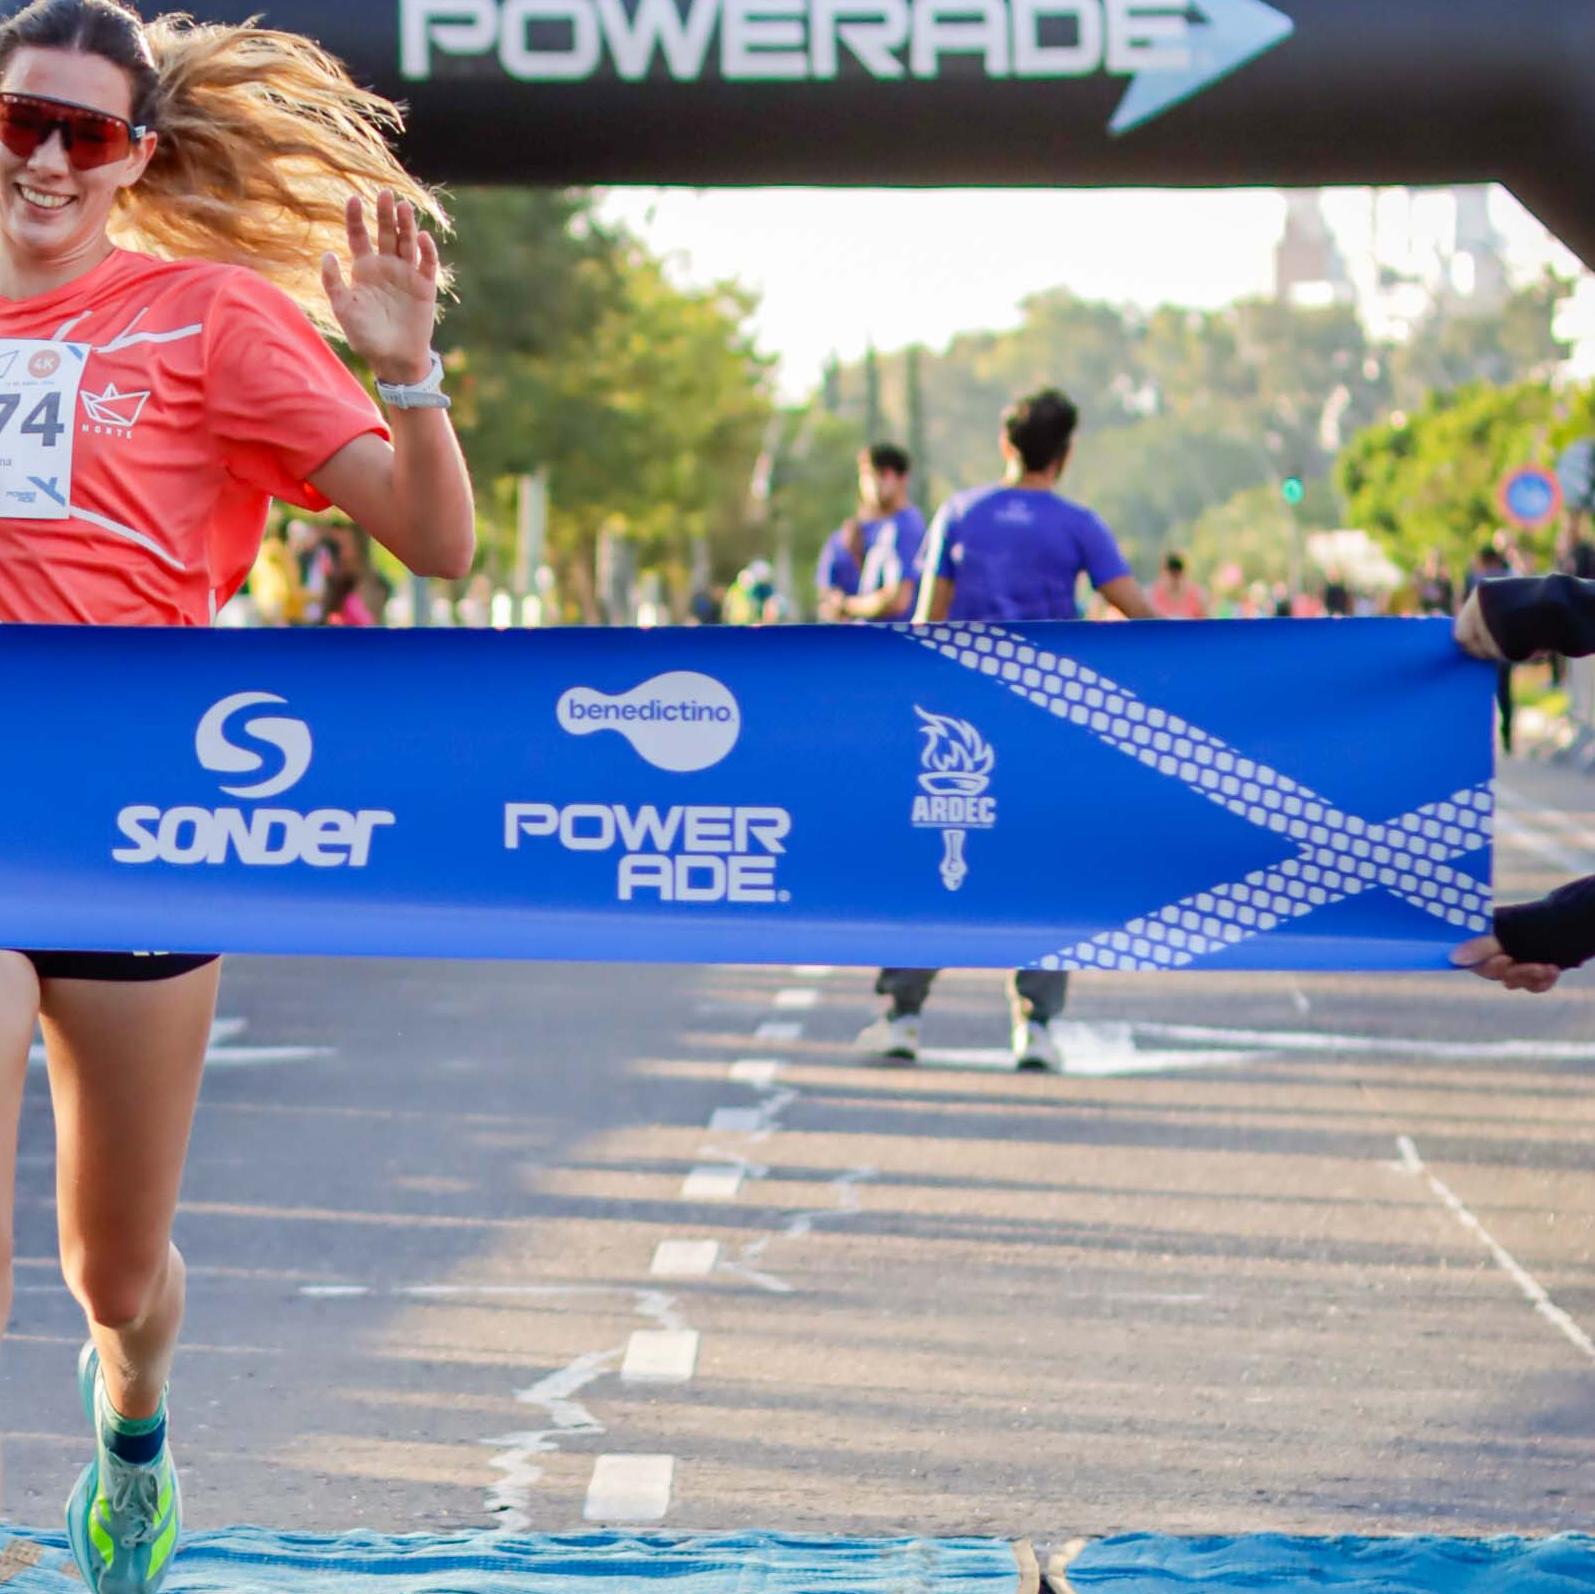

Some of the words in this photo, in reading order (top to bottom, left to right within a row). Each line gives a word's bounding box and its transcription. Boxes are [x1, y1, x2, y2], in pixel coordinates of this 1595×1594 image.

[34, 356, 55, 371] 4K
[81, 424, 133, 440] NORTE
[568, 698, 732, 723] benedictino
[911, 795, 997, 823] ARDEC
[504, 802, 792, 854] POWER
